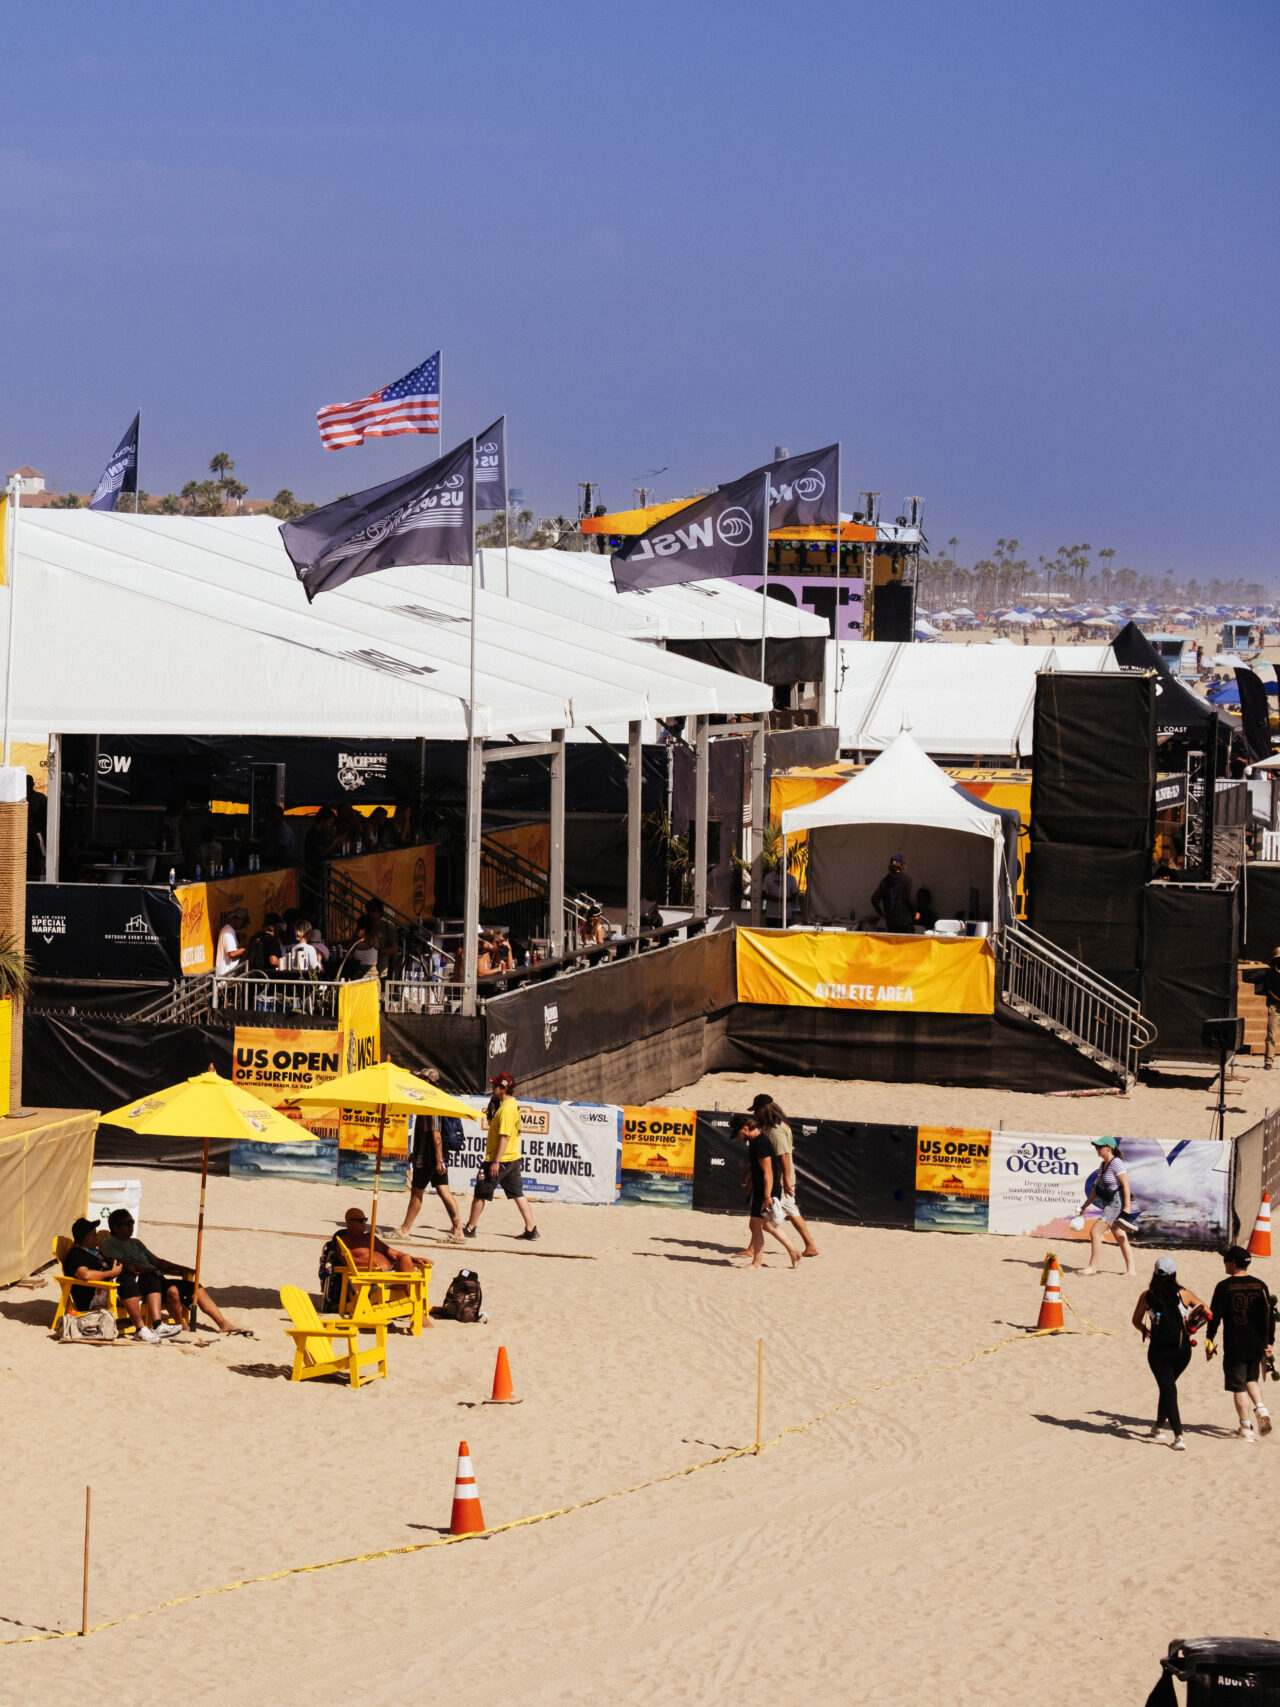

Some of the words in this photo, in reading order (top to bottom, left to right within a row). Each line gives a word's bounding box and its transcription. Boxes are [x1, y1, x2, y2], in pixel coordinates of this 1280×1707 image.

[32, 926, 66, 934] WARFARE
[814, 982, 874, 1000] ATHLETE
[876, 985, 914, 1002] AREA
[237, 1048, 269, 1069] US
[272, 1051, 339, 1072] OPEN
[357, 1036, 378, 1071] WSL
[236, 1069, 253, 1079] OF
[255, 1070, 313, 1083] SURFING
[521, 1115, 546, 1125] NALS
[588, 1113, 609, 1123] WSL
[625, 1120, 647, 1133] US
[650, 1122, 694, 1136] OPEN
[638, 1134, 676, 1143] SURFING
[530, 1140, 544, 1156] BE
[547, 1141, 582, 1160] MADE.
[919, 1140, 942, 1154] US
[944, 1143, 989, 1157] OPEN
[1021, 1142, 1066, 1160] One
[448, 1152, 483, 1169] GENDS
[534, 1157, 595, 1178] CROWNED.
[932, 1156, 972, 1164] SURFING
[1006, 1156, 1079, 1176] Ocean
[1008, 1187, 1055, 1195] sustainability
[1024, 1180, 1043, 1188] Drop
[1002, 1194, 1021, 1202] using
